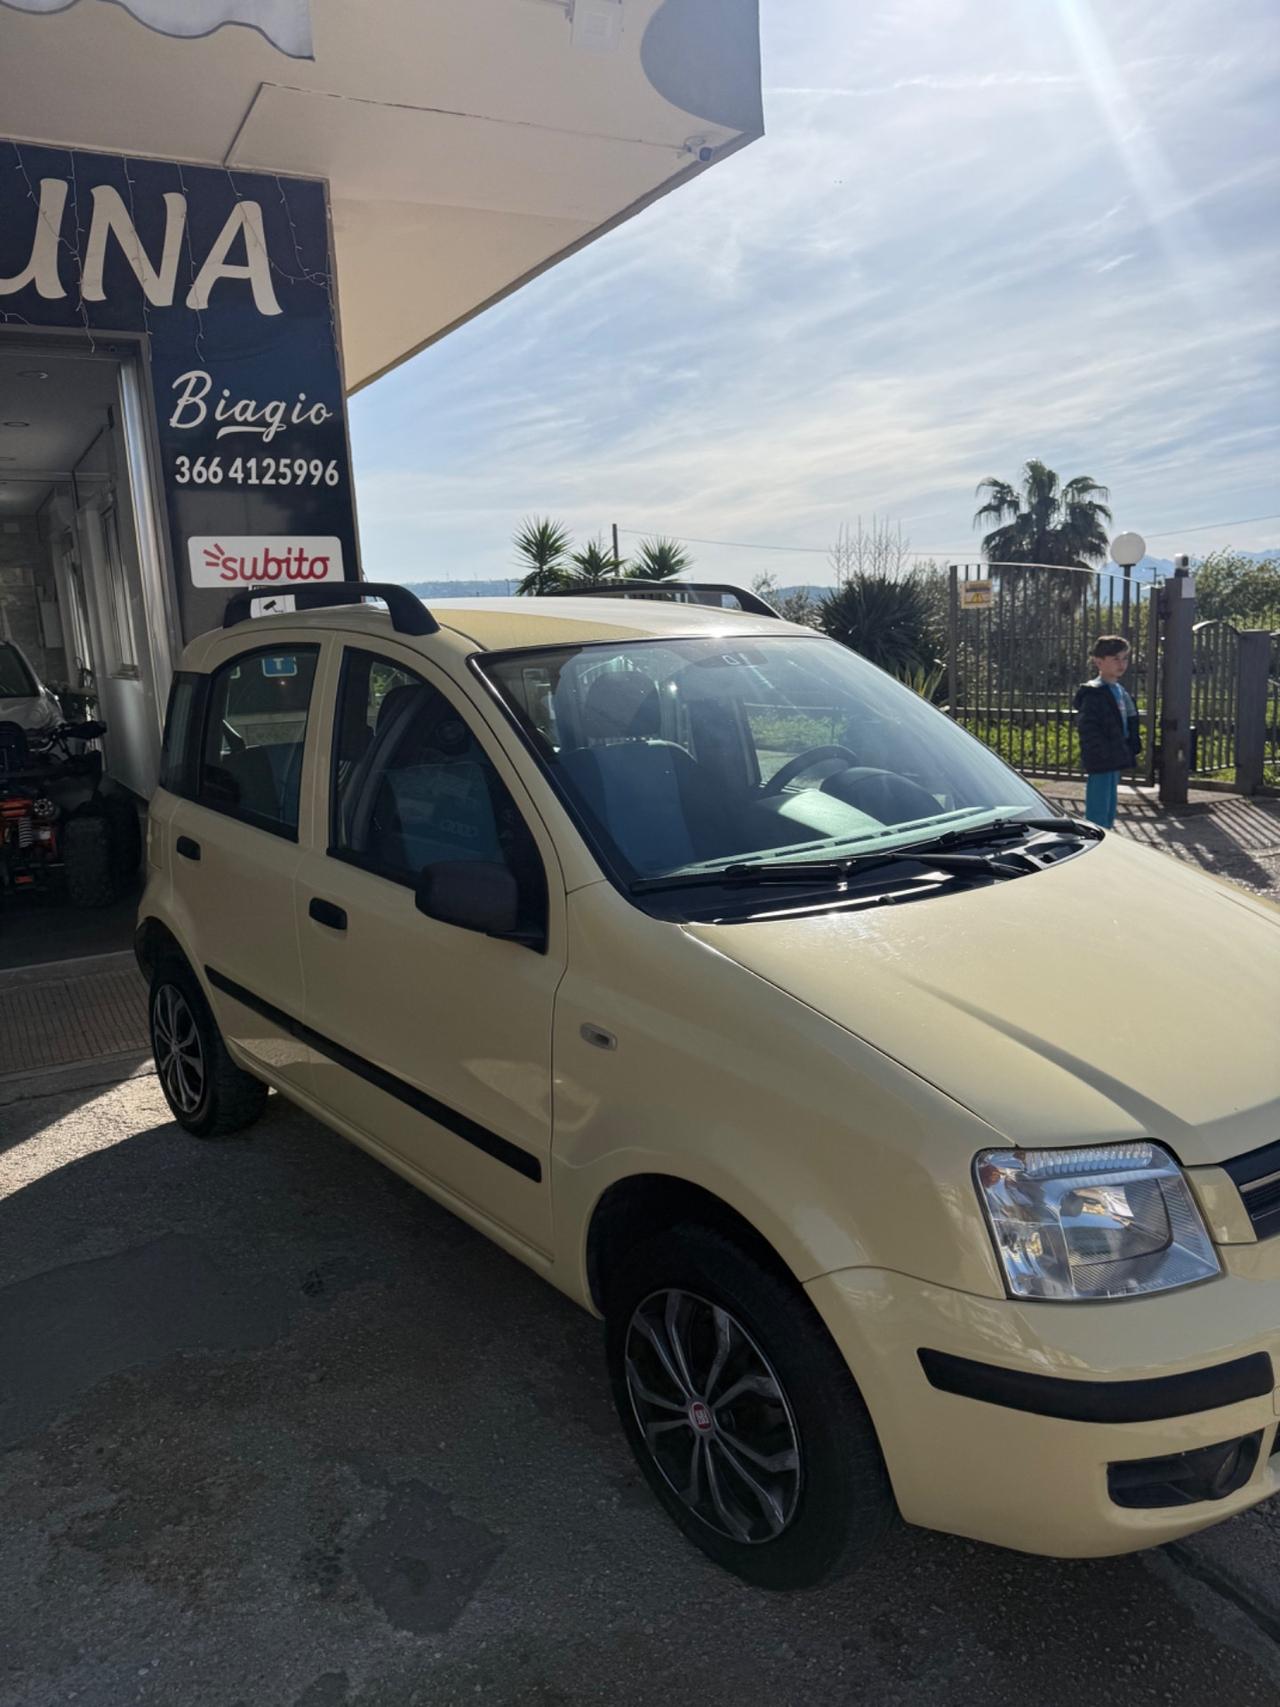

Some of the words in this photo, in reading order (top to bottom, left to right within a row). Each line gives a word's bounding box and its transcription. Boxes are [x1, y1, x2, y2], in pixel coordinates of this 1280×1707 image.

[169, 370, 334, 443] Biagio
[175, 455, 224, 484] 366
[228, 457, 340, 487] 4125996
[219, 546, 331, 582] subito
